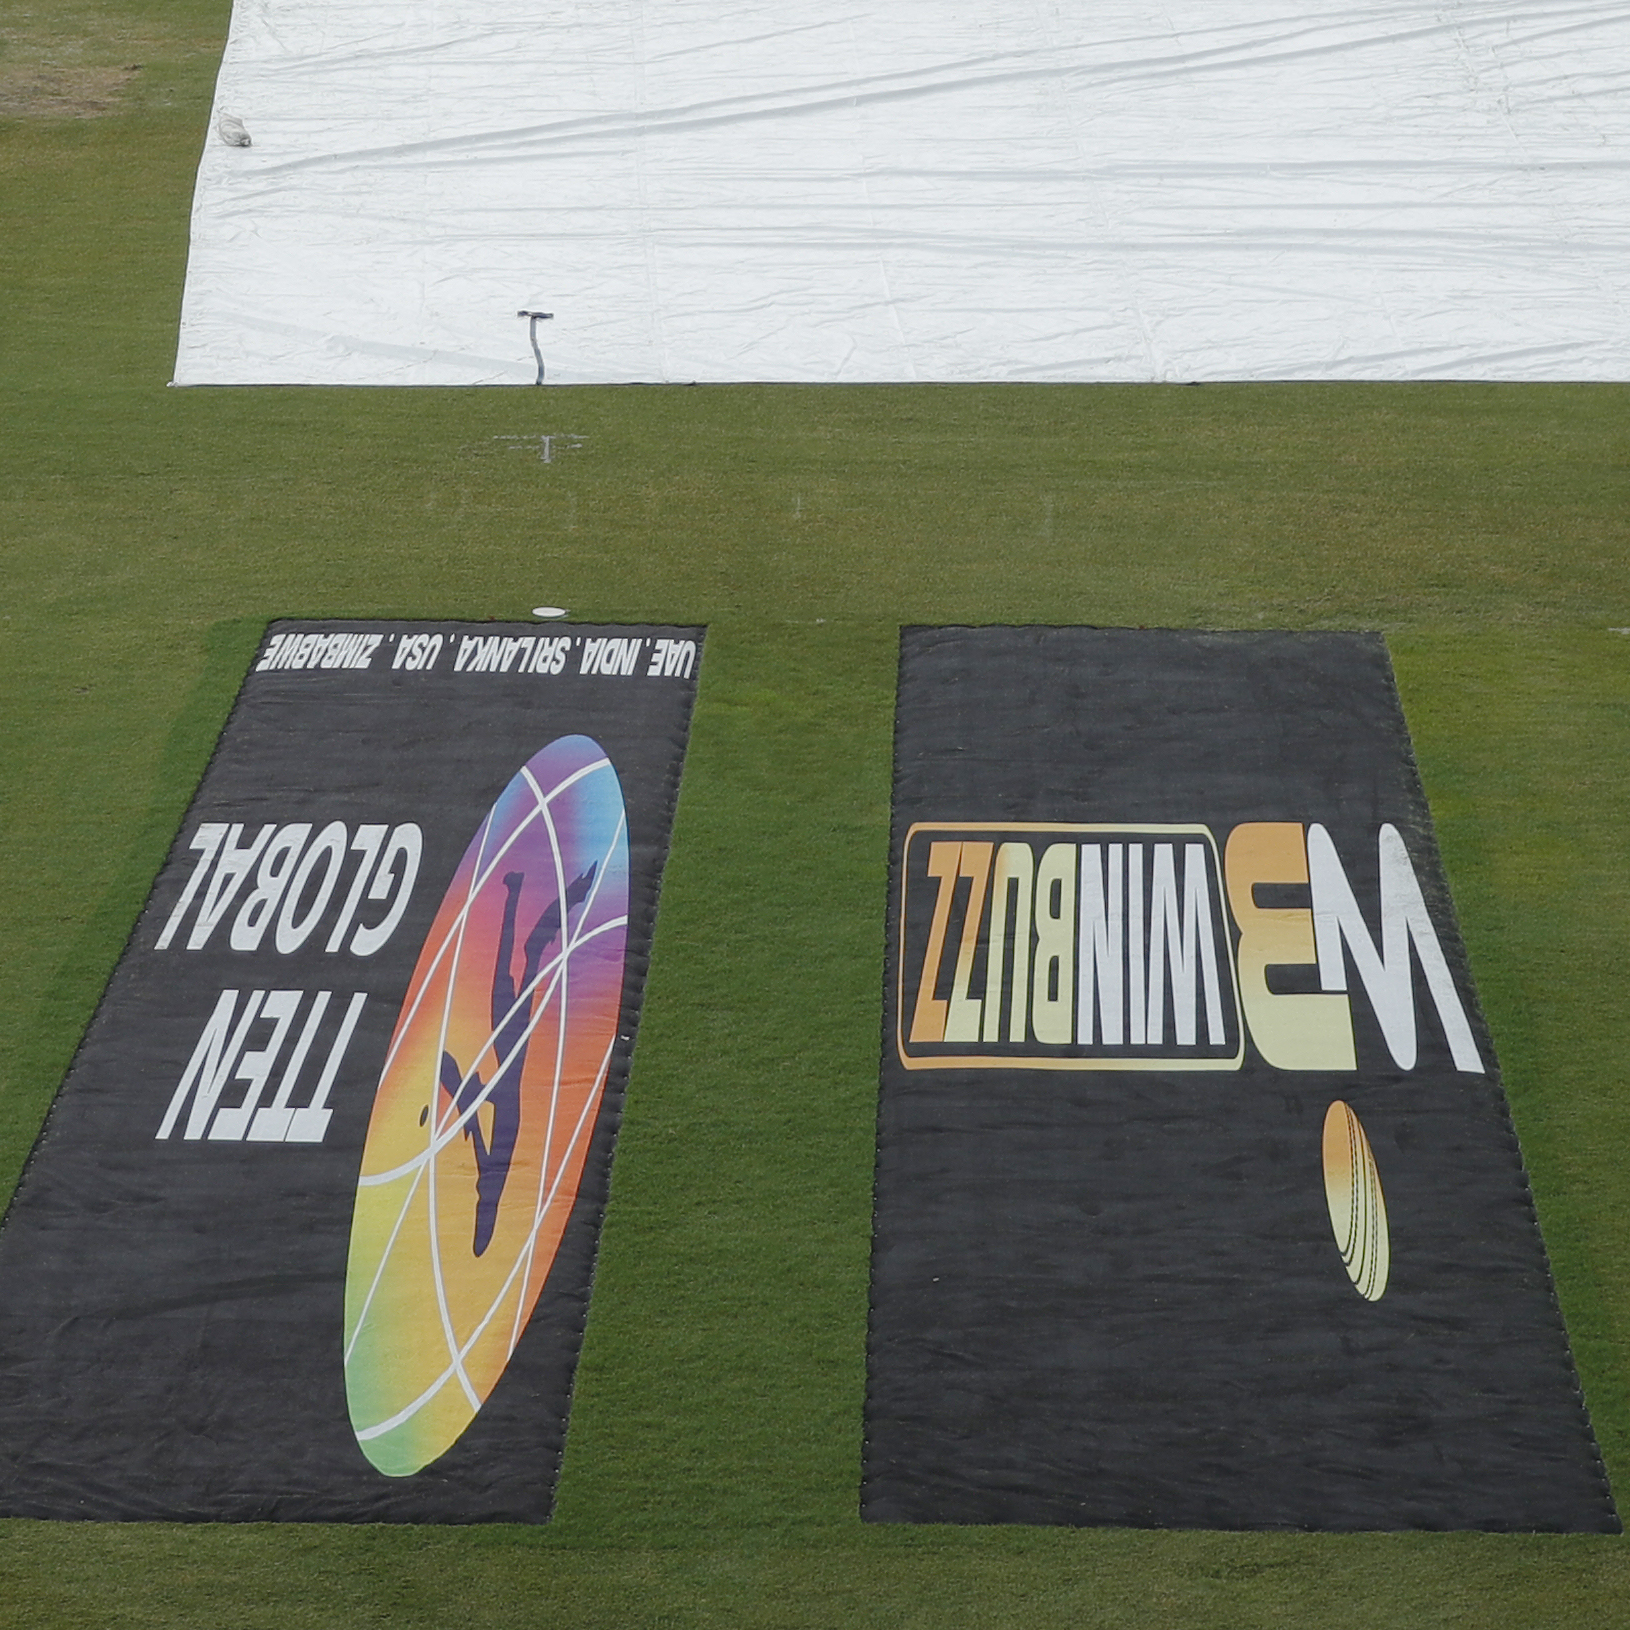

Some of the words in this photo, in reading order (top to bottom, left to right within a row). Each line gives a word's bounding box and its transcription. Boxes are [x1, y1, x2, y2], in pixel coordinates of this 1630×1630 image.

[256, 632, 384, 672] ZIMBABWE
[153, 820, 423, 957] GLOBAL
[908, 841, 1226, 1046] WINBUZZ
[154, 988, 368, 1143] TTEN
